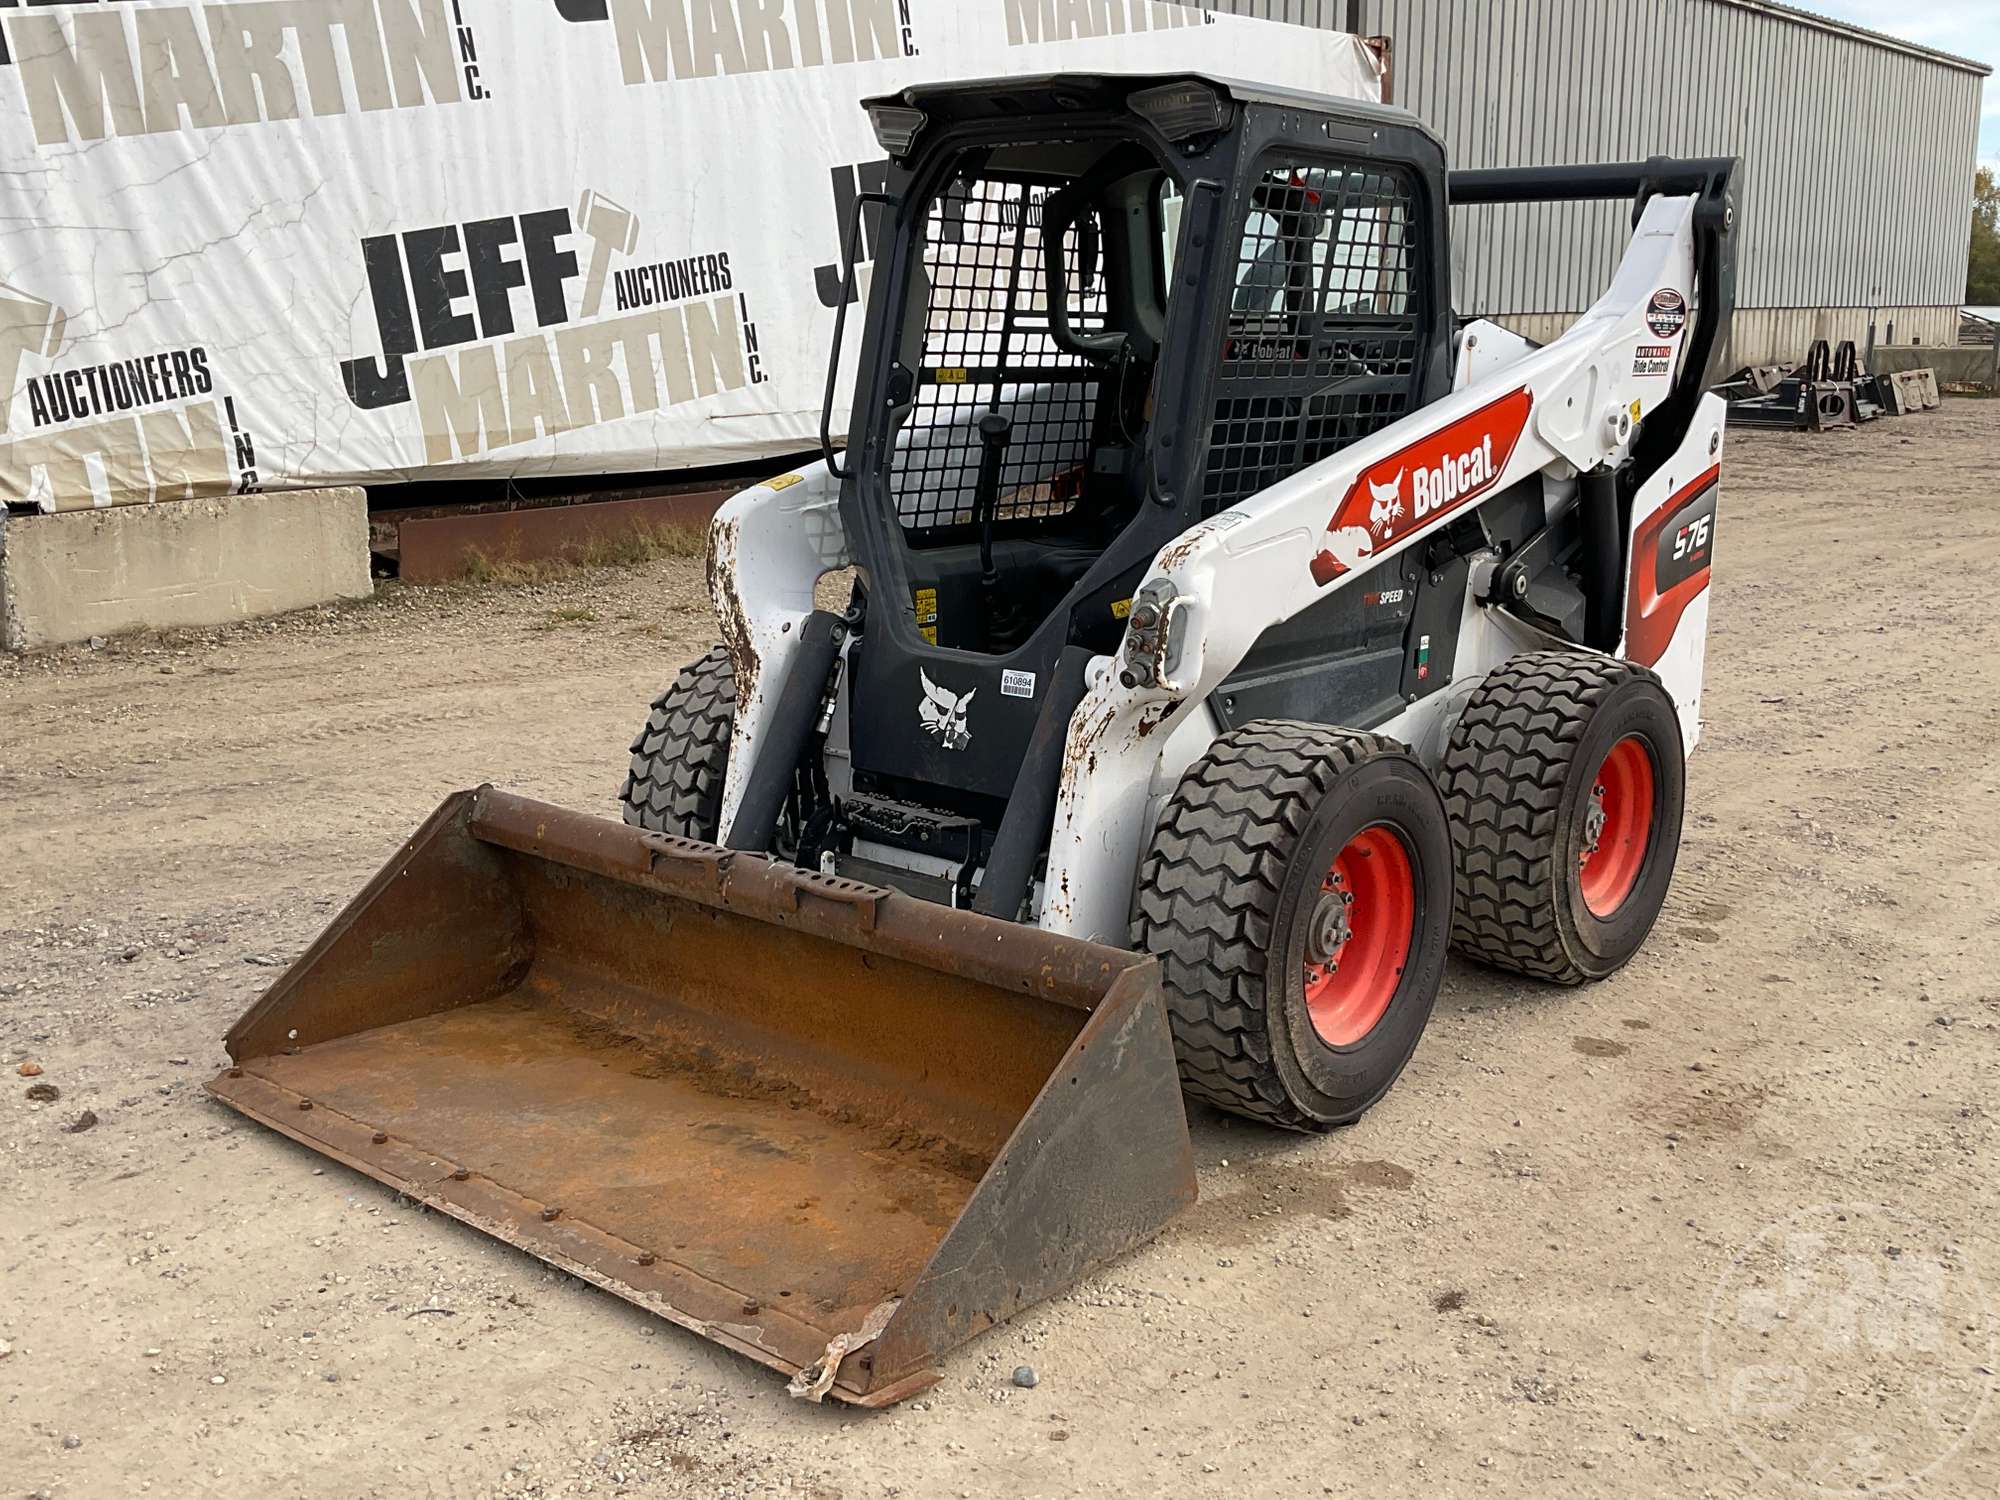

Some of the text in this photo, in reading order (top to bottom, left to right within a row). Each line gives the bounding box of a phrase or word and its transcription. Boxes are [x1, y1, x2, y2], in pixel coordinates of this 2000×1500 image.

[8, 0, 462, 145] MARTIN
[612, 0, 900, 86] MARTIN
[340, 207, 580, 410] JEFF
[614, 251, 733, 312] AUCTIONEERS
[409, 295, 746, 466] MARTIN
[738, 292, 769, 385] INC.
[26, 346, 213, 427] AUCTIONEERS
[1672, 513, 1711, 561] S76
[1003, 675, 1032, 688] 610894
